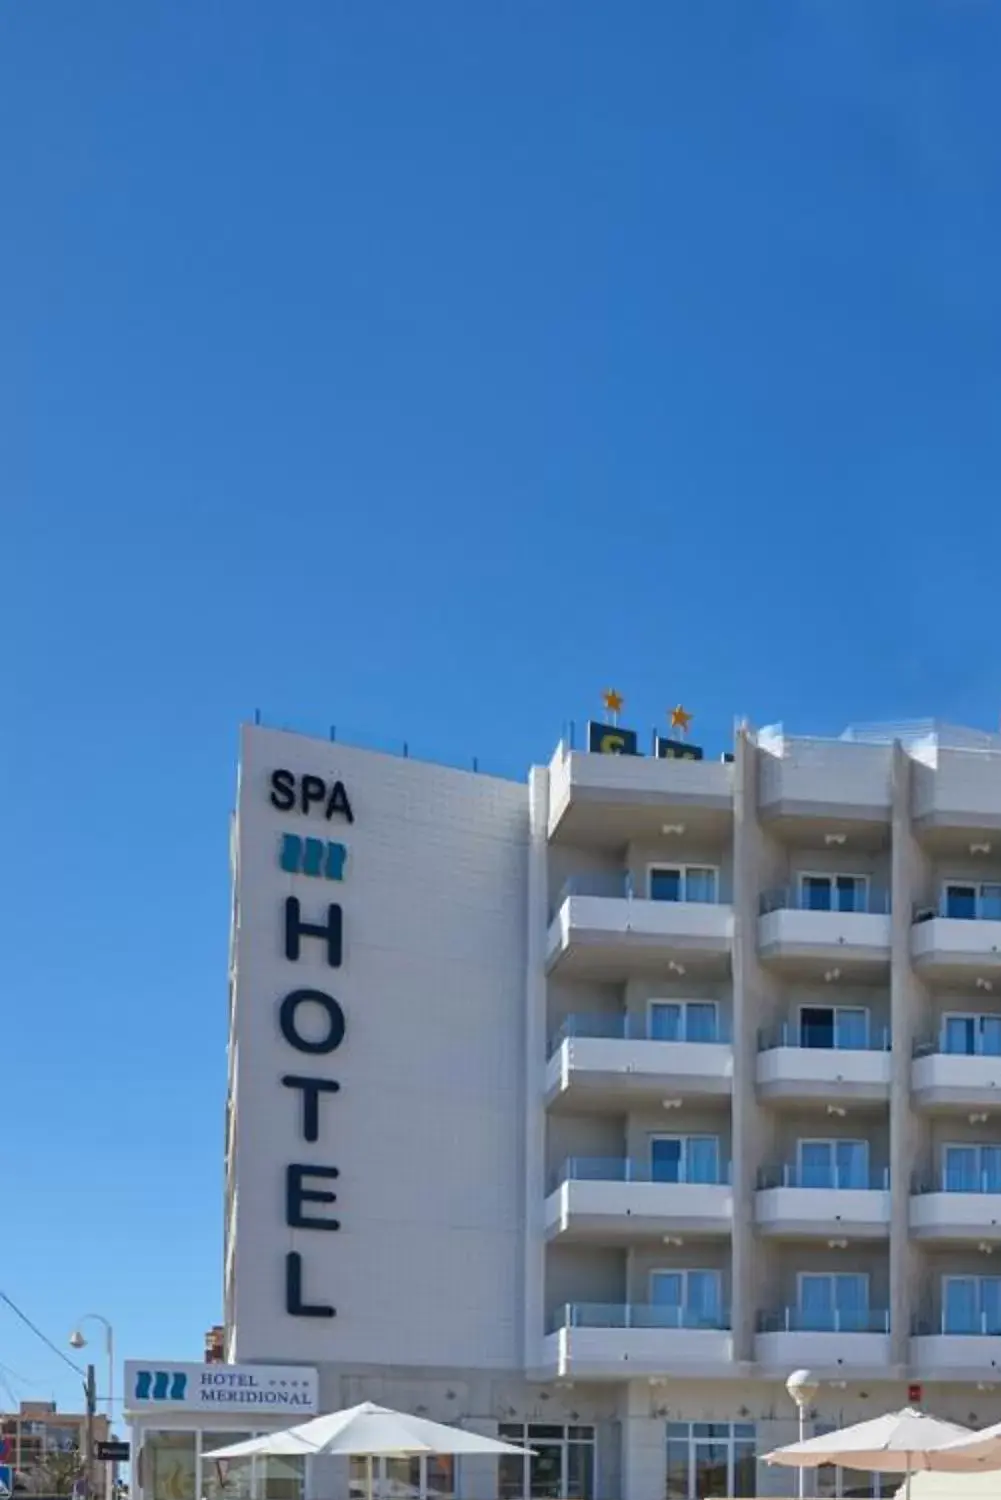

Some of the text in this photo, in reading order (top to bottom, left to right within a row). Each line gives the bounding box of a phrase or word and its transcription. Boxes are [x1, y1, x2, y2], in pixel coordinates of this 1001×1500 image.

[270, 769, 355, 825] SPA
[279, 895, 346, 1318] HOTEL
[200, 1372, 259, 1388] HOTEL
[200, 1389, 313, 1406] MERIDIONAL
